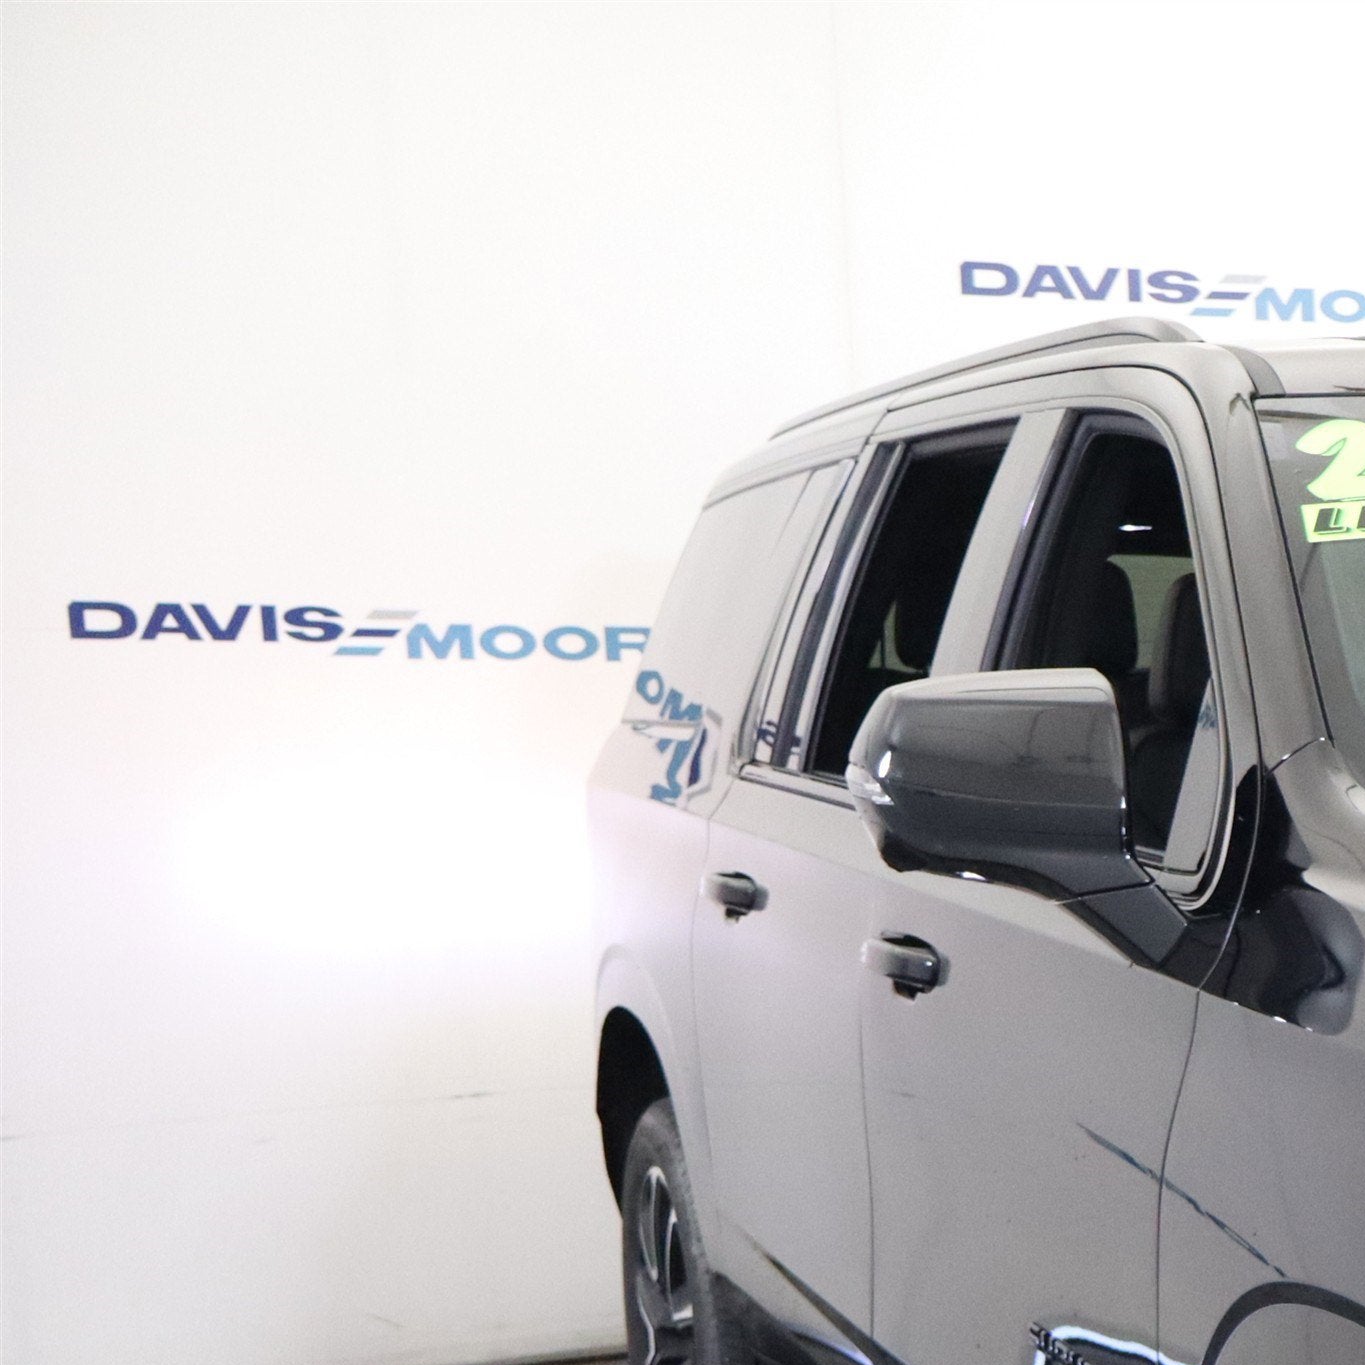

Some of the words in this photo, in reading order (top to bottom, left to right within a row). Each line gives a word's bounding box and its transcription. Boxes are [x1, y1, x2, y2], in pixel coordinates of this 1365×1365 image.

[960, 261, 1198, 304] DAVIS
[67, 601, 344, 643] DAVIS
[406, 623, 652, 662] MOOR
